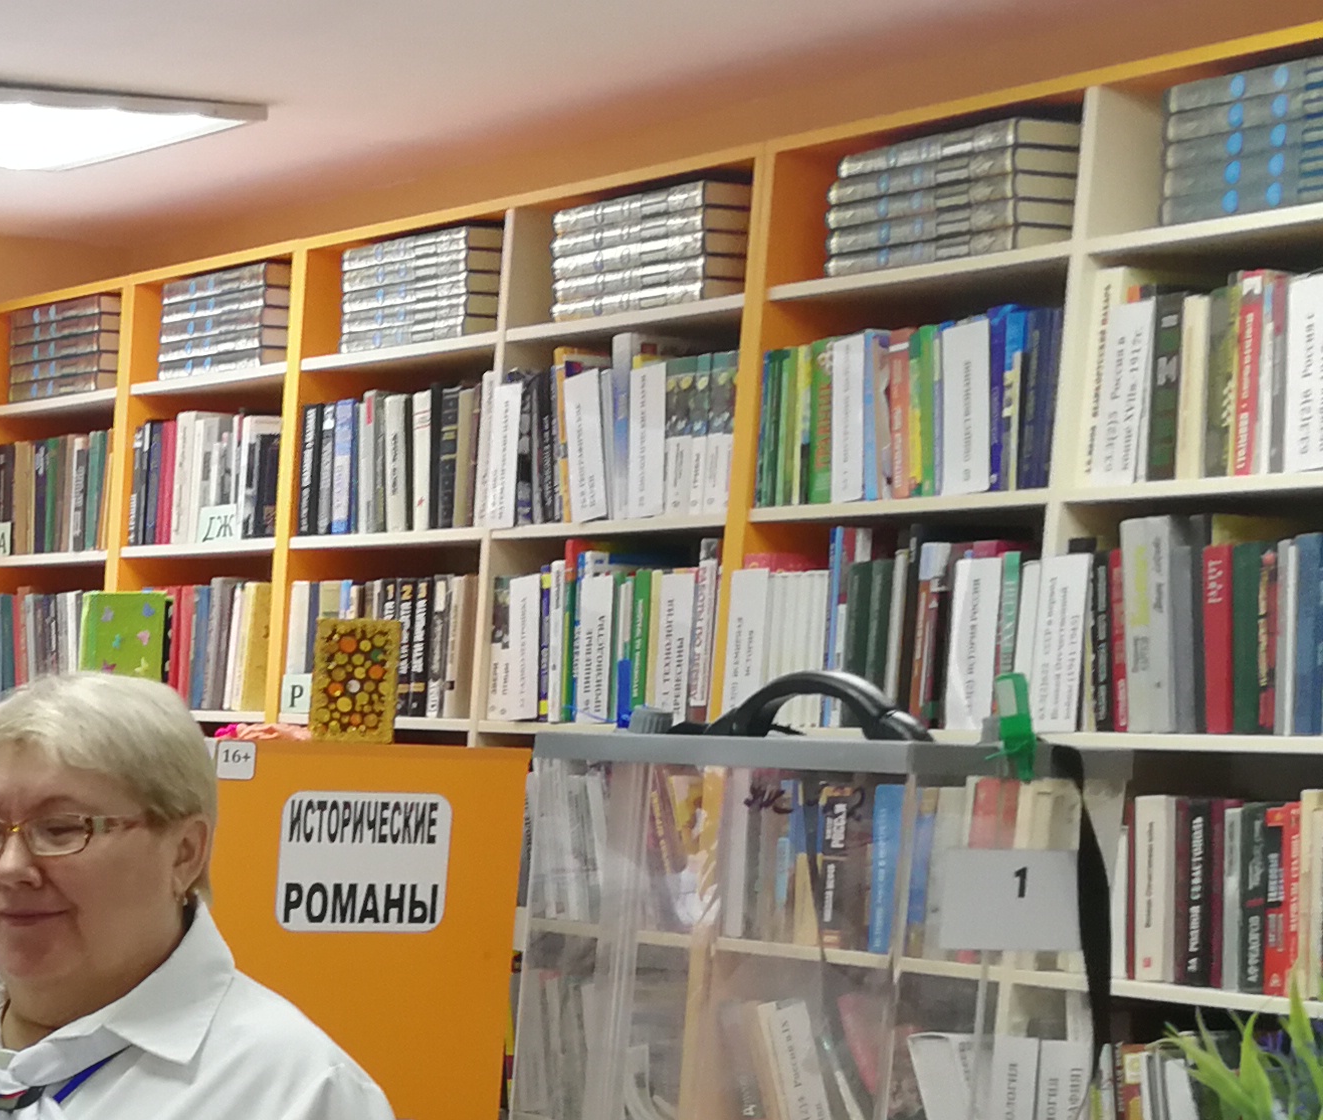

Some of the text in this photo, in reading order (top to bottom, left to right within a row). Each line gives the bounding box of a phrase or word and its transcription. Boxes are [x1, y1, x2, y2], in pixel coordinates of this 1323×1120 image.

[595, 615, 606, 713] ПРОИЗВОДСТВА
[289, 684, 304, 708] Р
[222, 748, 251, 764] 16+
[288, 799, 438, 844] ИСТОРИЧЕСКИЕ
[1190, 816, 1204, 900] СЕВАСТОПОЛЬ
[283, 882, 438, 924] РОМАНЫ
[1014, 866, 1028, 899] 1
